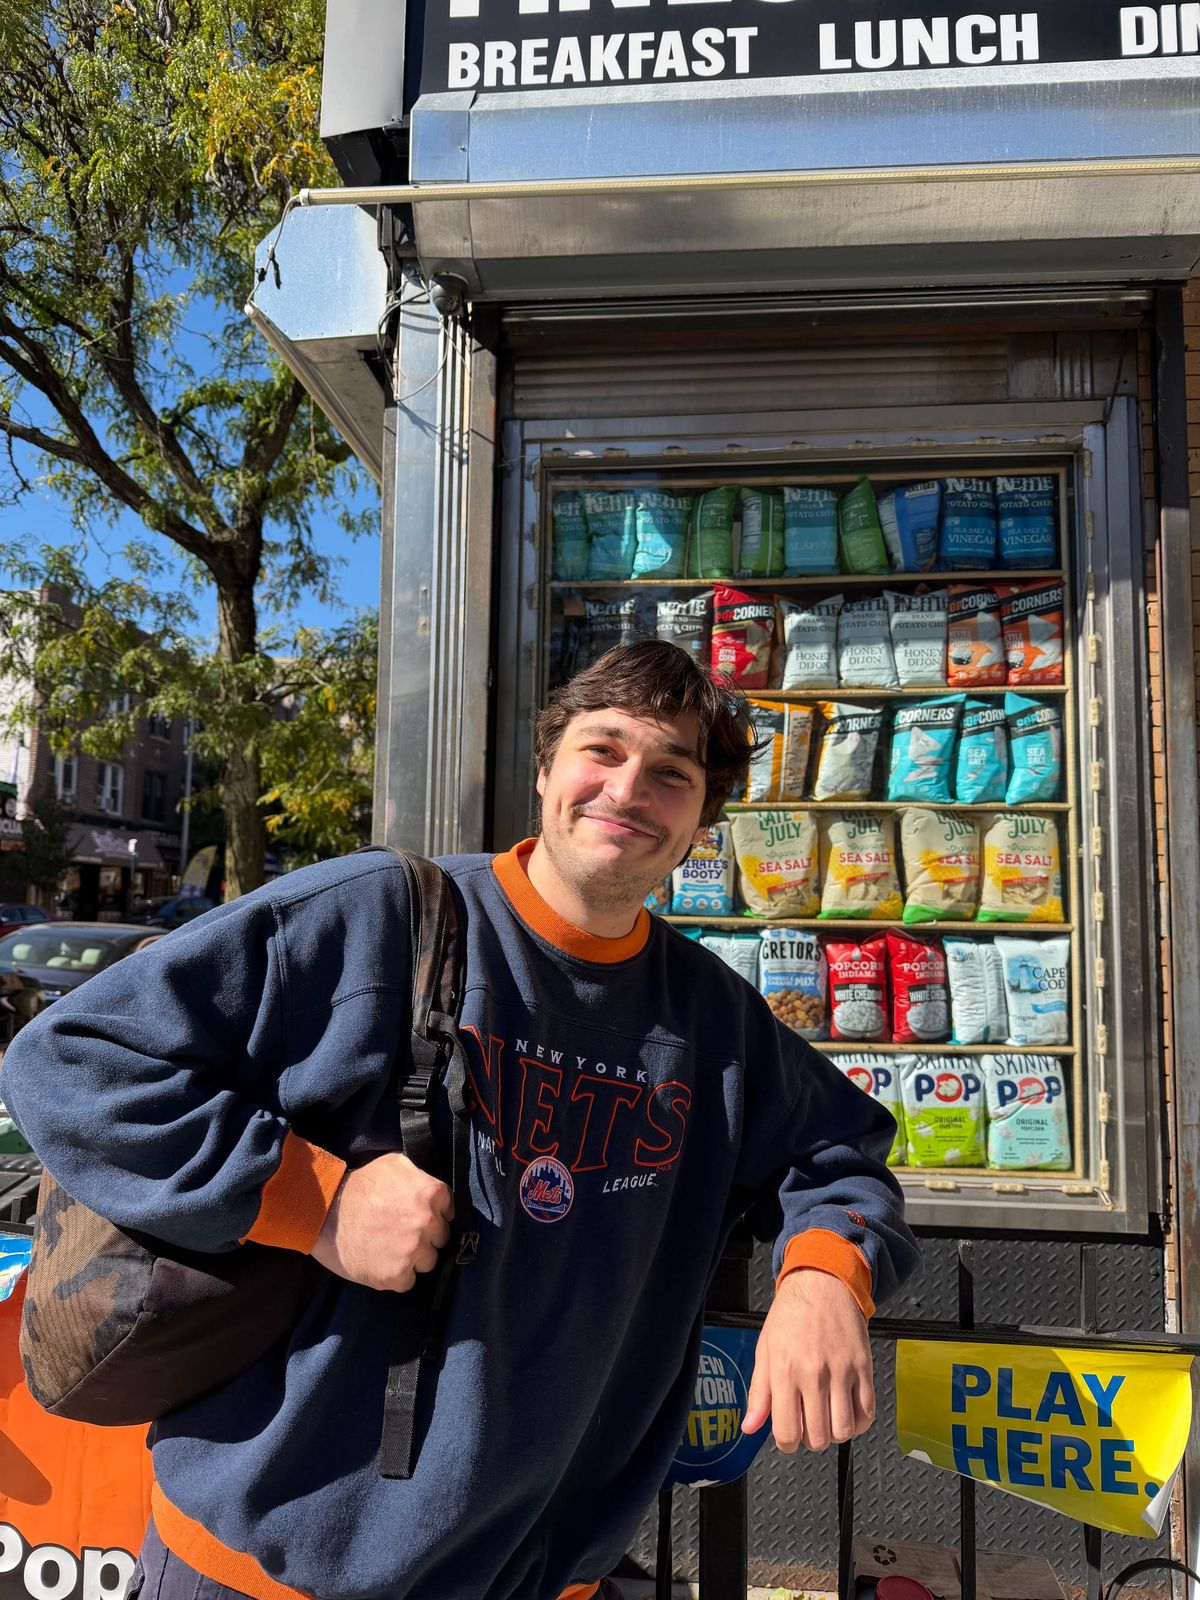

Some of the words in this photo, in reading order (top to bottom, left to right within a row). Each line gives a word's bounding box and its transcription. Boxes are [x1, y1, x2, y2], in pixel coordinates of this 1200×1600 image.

[448, 27, 758, 88] BREAKFAST
[819, 13, 1039, 70] LUNCH
[1003, 533, 1053, 546] VINEGAR
[1001, 587, 1063, 615] OPCORNERS
[714, 605, 775, 622] POPCORNER
[848, 654, 882, 665] DIJON
[904, 648, 944, 657] HONEY
[908, 658, 941, 667] DIJON
[967, 748, 986, 757] SEA
[1027, 747, 1046, 757] SEA
[1027, 756, 1046, 765] SALT
[968, 757, 986, 766] SALT
[765, 822, 802, 847] JULY
[847, 818, 884, 839] JULY
[944, 820, 976, 841] JULY
[1008, 817, 1046, 838] JULY
[684, 858, 729, 870] IRATE'S
[758, 862, 782, 873] SEA
[785, 857, 812, 870] SALT
[839, 852, 862, 863] SEA
[865, 852, 890, 863] SALT
[996, 853, 1021, 864] SEA
[1025, 854, 1053, 867] SALT
[682, 869, 723, 879] BOOTY
[1032, 966, 1066, 979] CAPE
[1038, 978, 1065, 991] COD
[515, 1039, 564, 1064] NEW
[576, 1056, 648, 1083] YORK
[846, 1067, 892, 1096] OP
[914, 1073, 981, 1102] POP
[997, 1076, 1062, 1107] POP
[528, 1179, 563, 1204] Mets
[602, 1173, 656, 1193] LEAGUE
[951, 1363, 1127, 1428] PLAY
[687, 1408, 741, 1448] TERY
[951, 1423, 1160, 1499] HERE.
